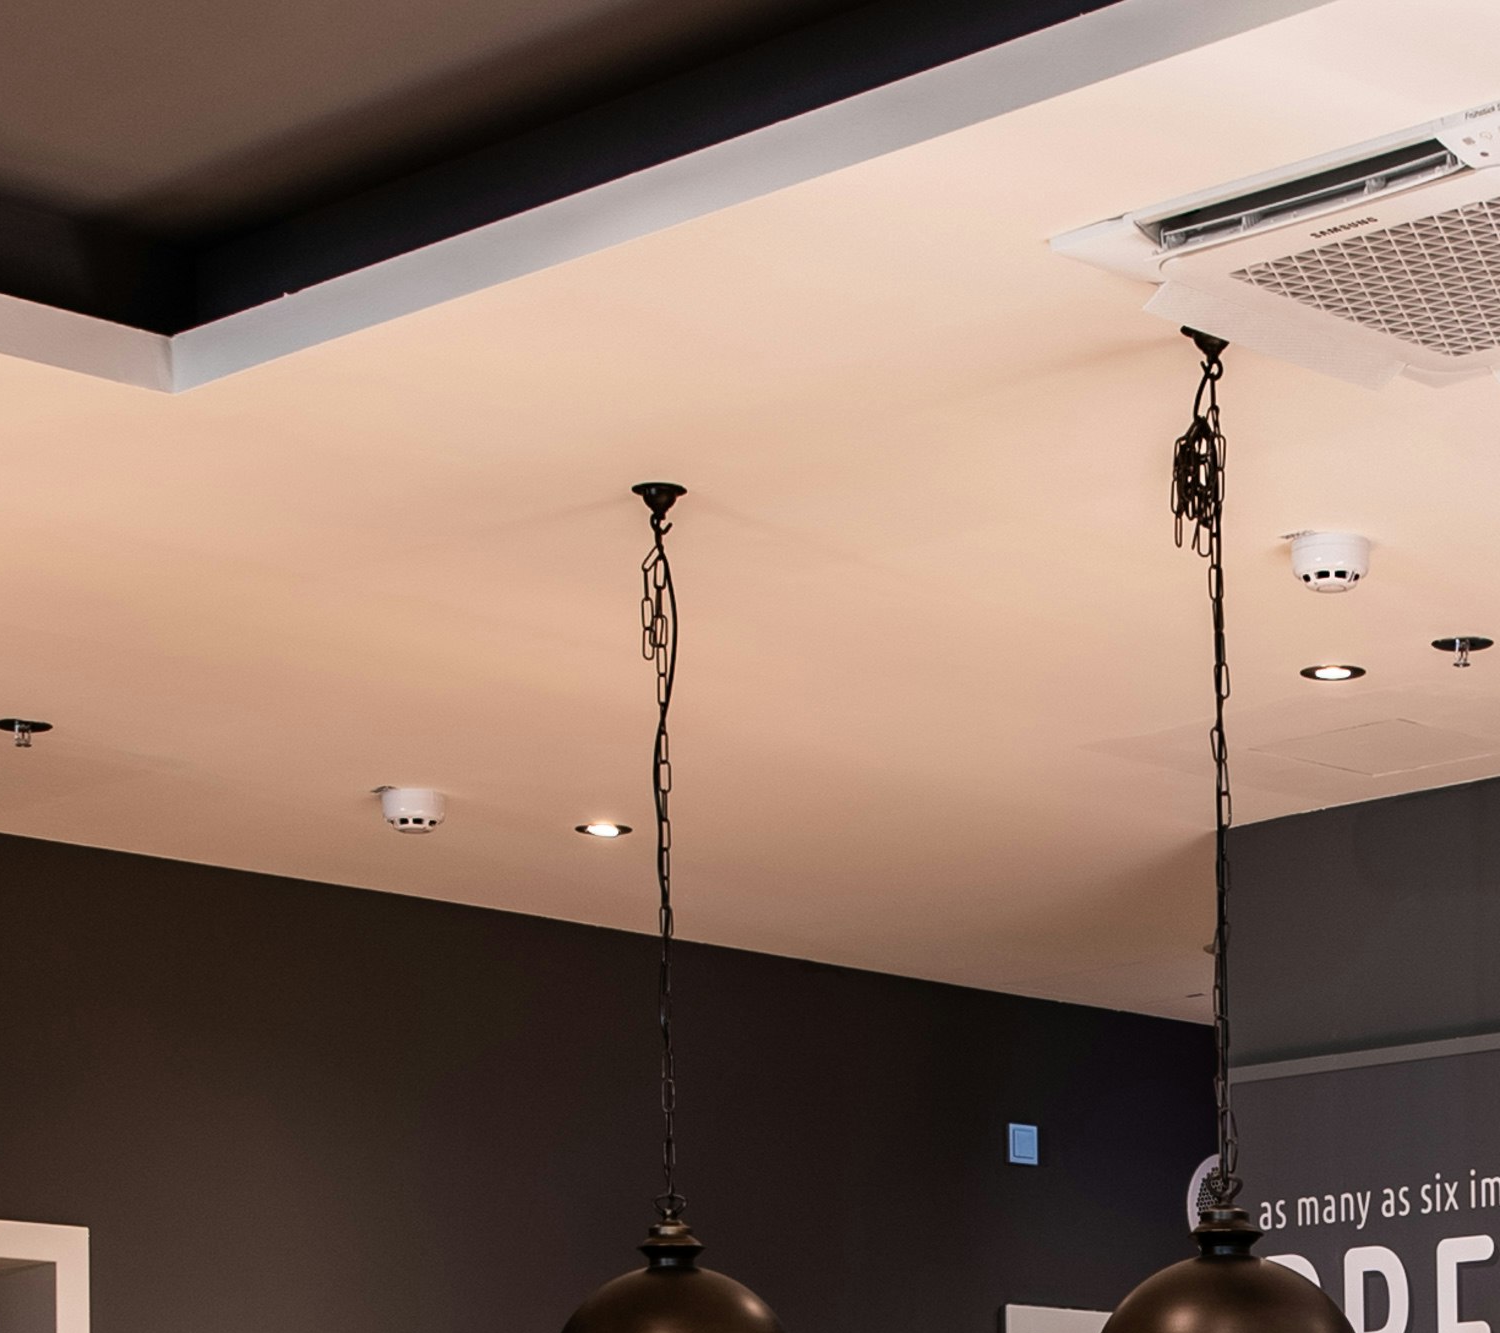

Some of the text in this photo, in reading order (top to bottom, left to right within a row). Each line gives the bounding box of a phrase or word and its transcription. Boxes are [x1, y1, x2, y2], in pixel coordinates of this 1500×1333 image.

[1309, 216, 1378, 238] SAMSUNG
[1258, 1200, 1287, 1231] as
[1296, 1191, 1371, 1231] many
[1380, 1186, 1411, 1218] as
[1419, 1172, 1460, 1215] six
